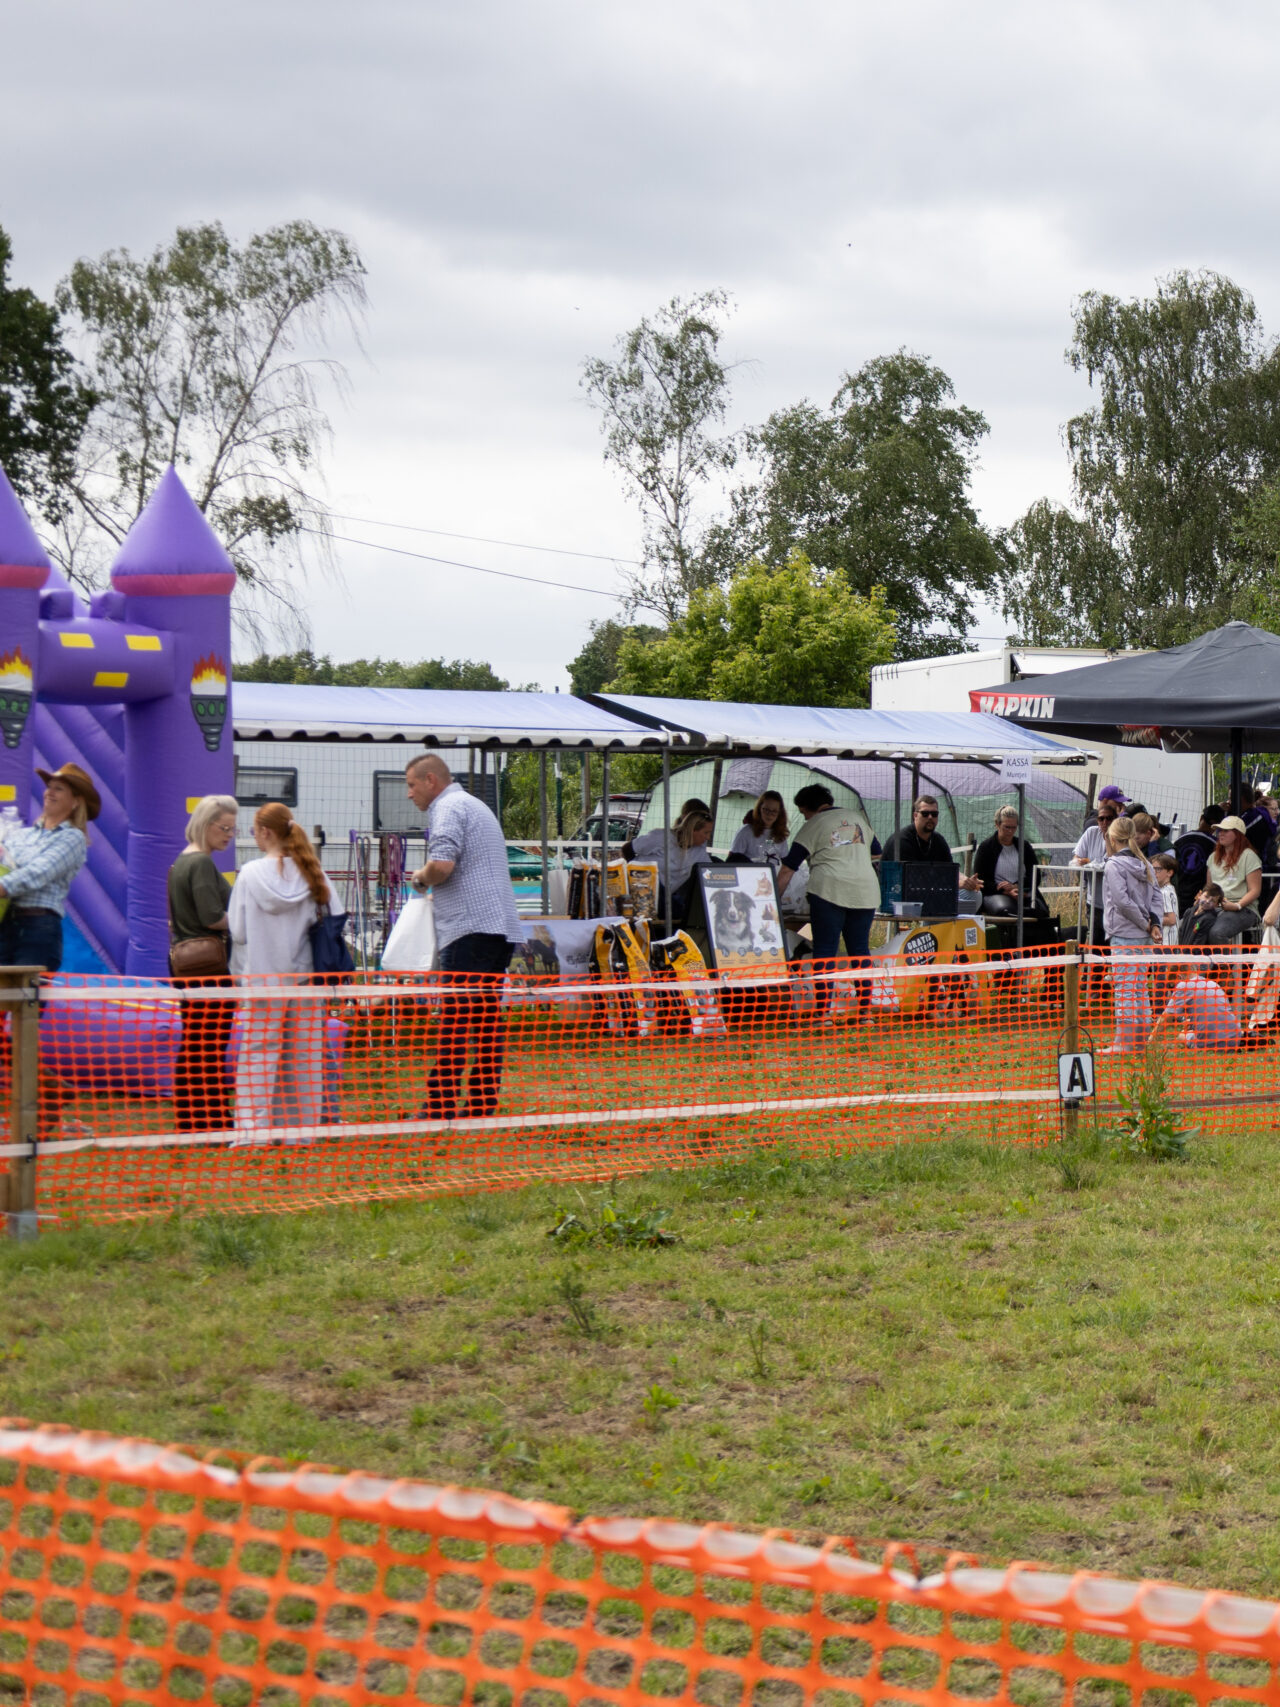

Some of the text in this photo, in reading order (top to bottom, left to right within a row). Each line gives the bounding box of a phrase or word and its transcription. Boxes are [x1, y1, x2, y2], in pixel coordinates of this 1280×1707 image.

[980, 696, 1055, 718] HAPKIN
[1006, 758, 1029, 767] KASSA
[907, 933, 932, 950] GRATIS
[1067, 1057, 1088, 1092] A
